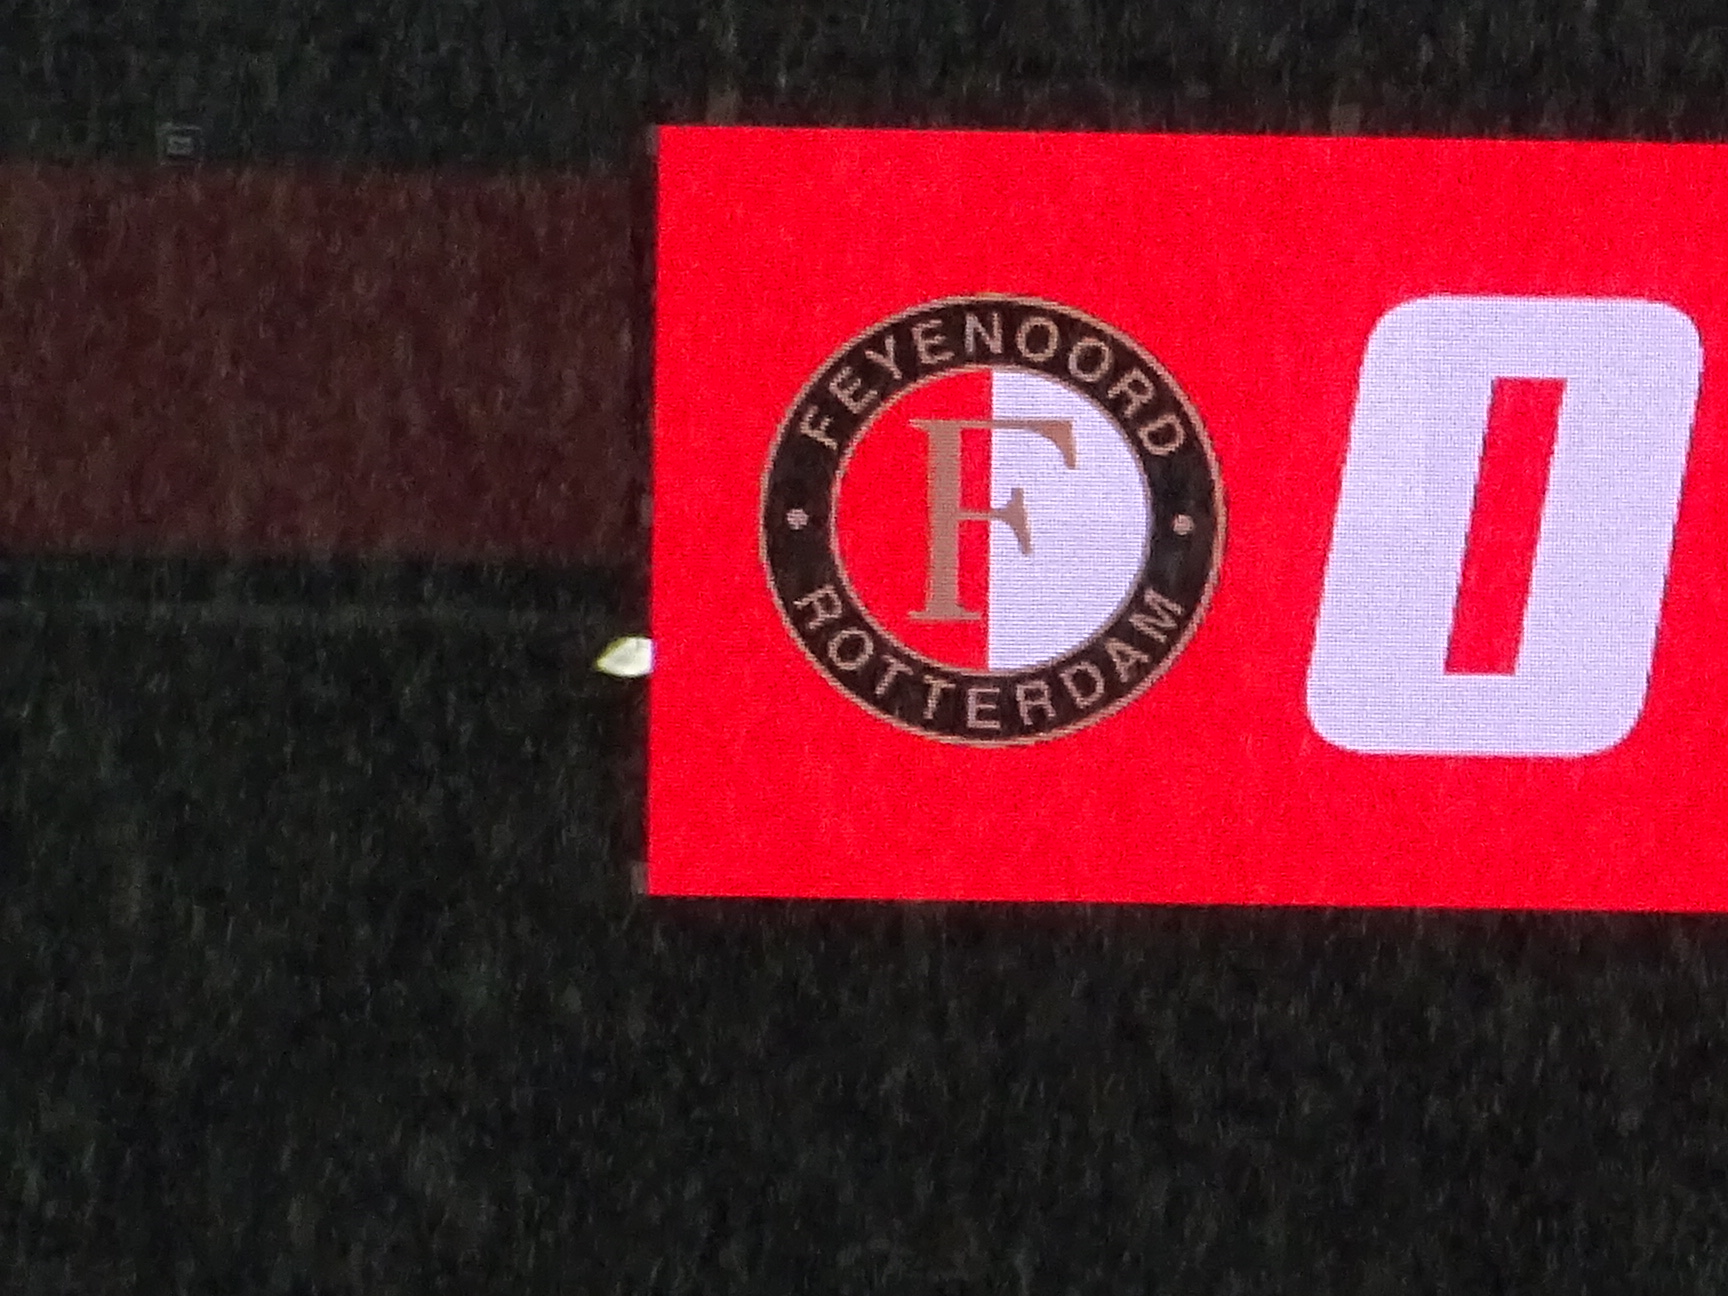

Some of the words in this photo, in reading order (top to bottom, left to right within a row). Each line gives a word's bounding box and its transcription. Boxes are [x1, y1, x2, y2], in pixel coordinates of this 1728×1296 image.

[800, 312, 1187, 458] FEYENOORD
[907, 418, 1078, 622] F
[1306, 293, 1704, 758] 0
[793, 584, 1186, 729] ROTTERDAM
